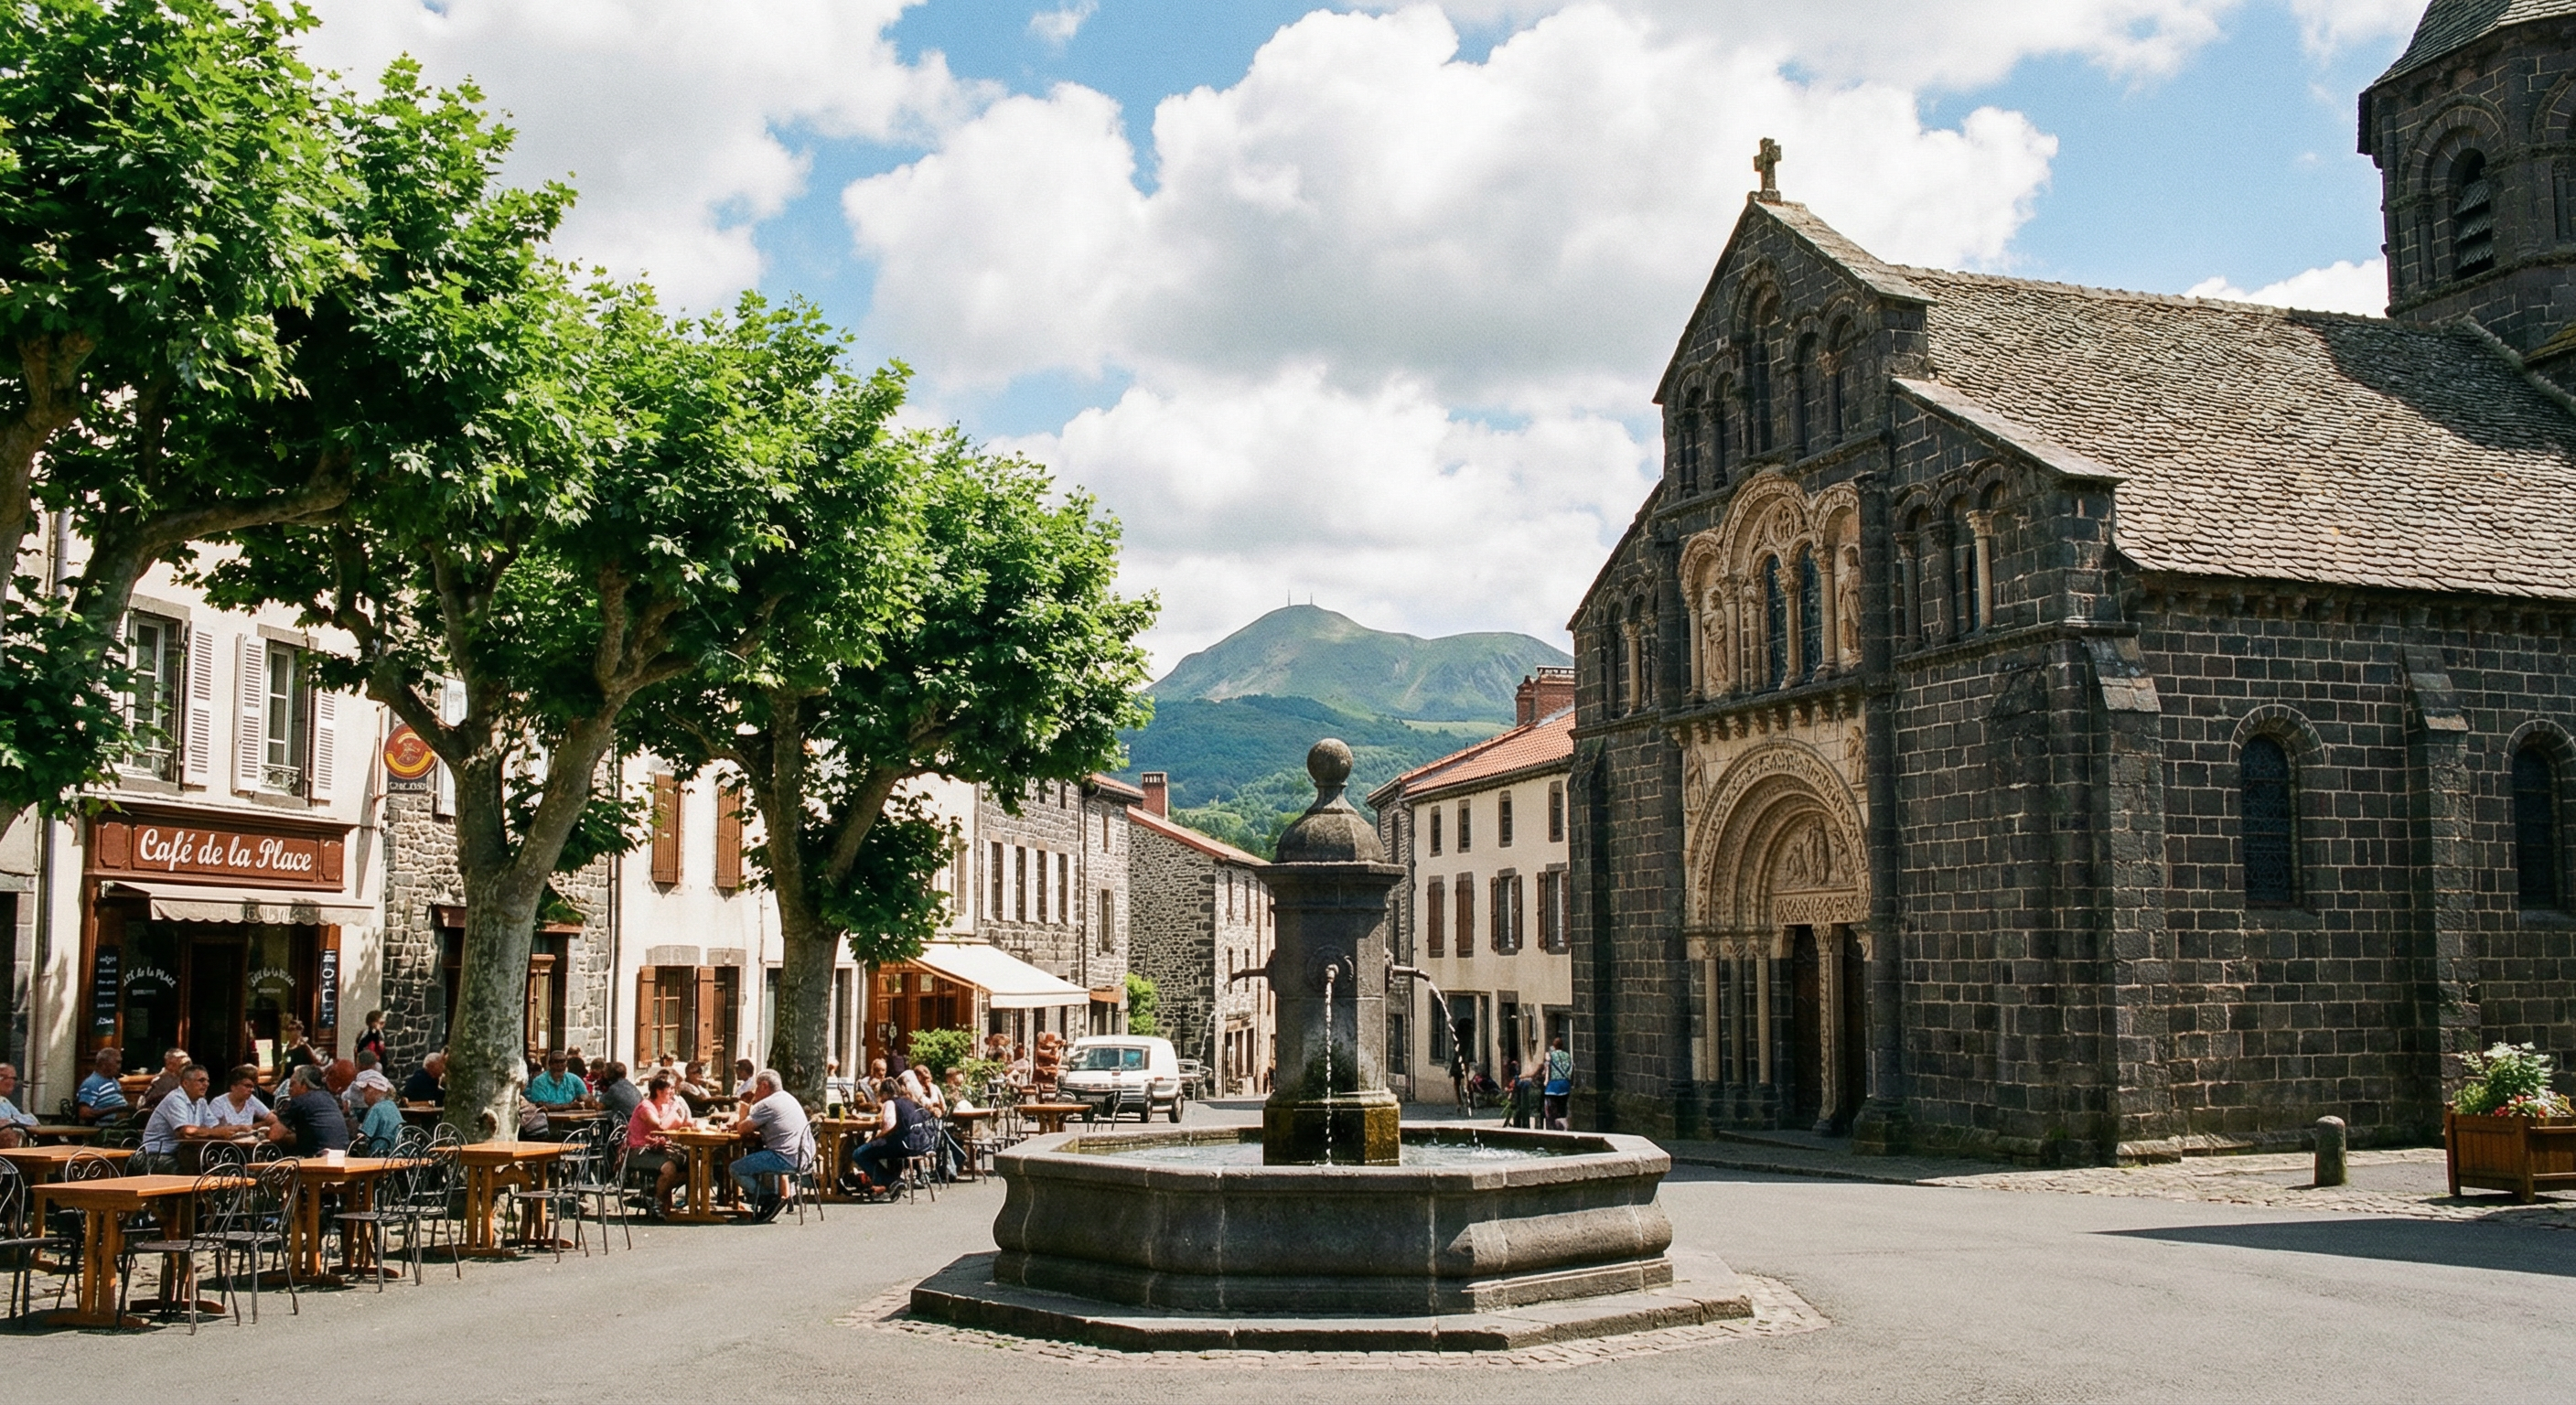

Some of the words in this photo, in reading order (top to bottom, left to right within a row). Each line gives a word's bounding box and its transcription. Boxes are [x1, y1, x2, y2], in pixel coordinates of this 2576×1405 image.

[140, 828, 196, 871] Café
[197, 833, 223, 865] de
[228, 835, 252, 868] la
[255, 838, 312, 872] Place
